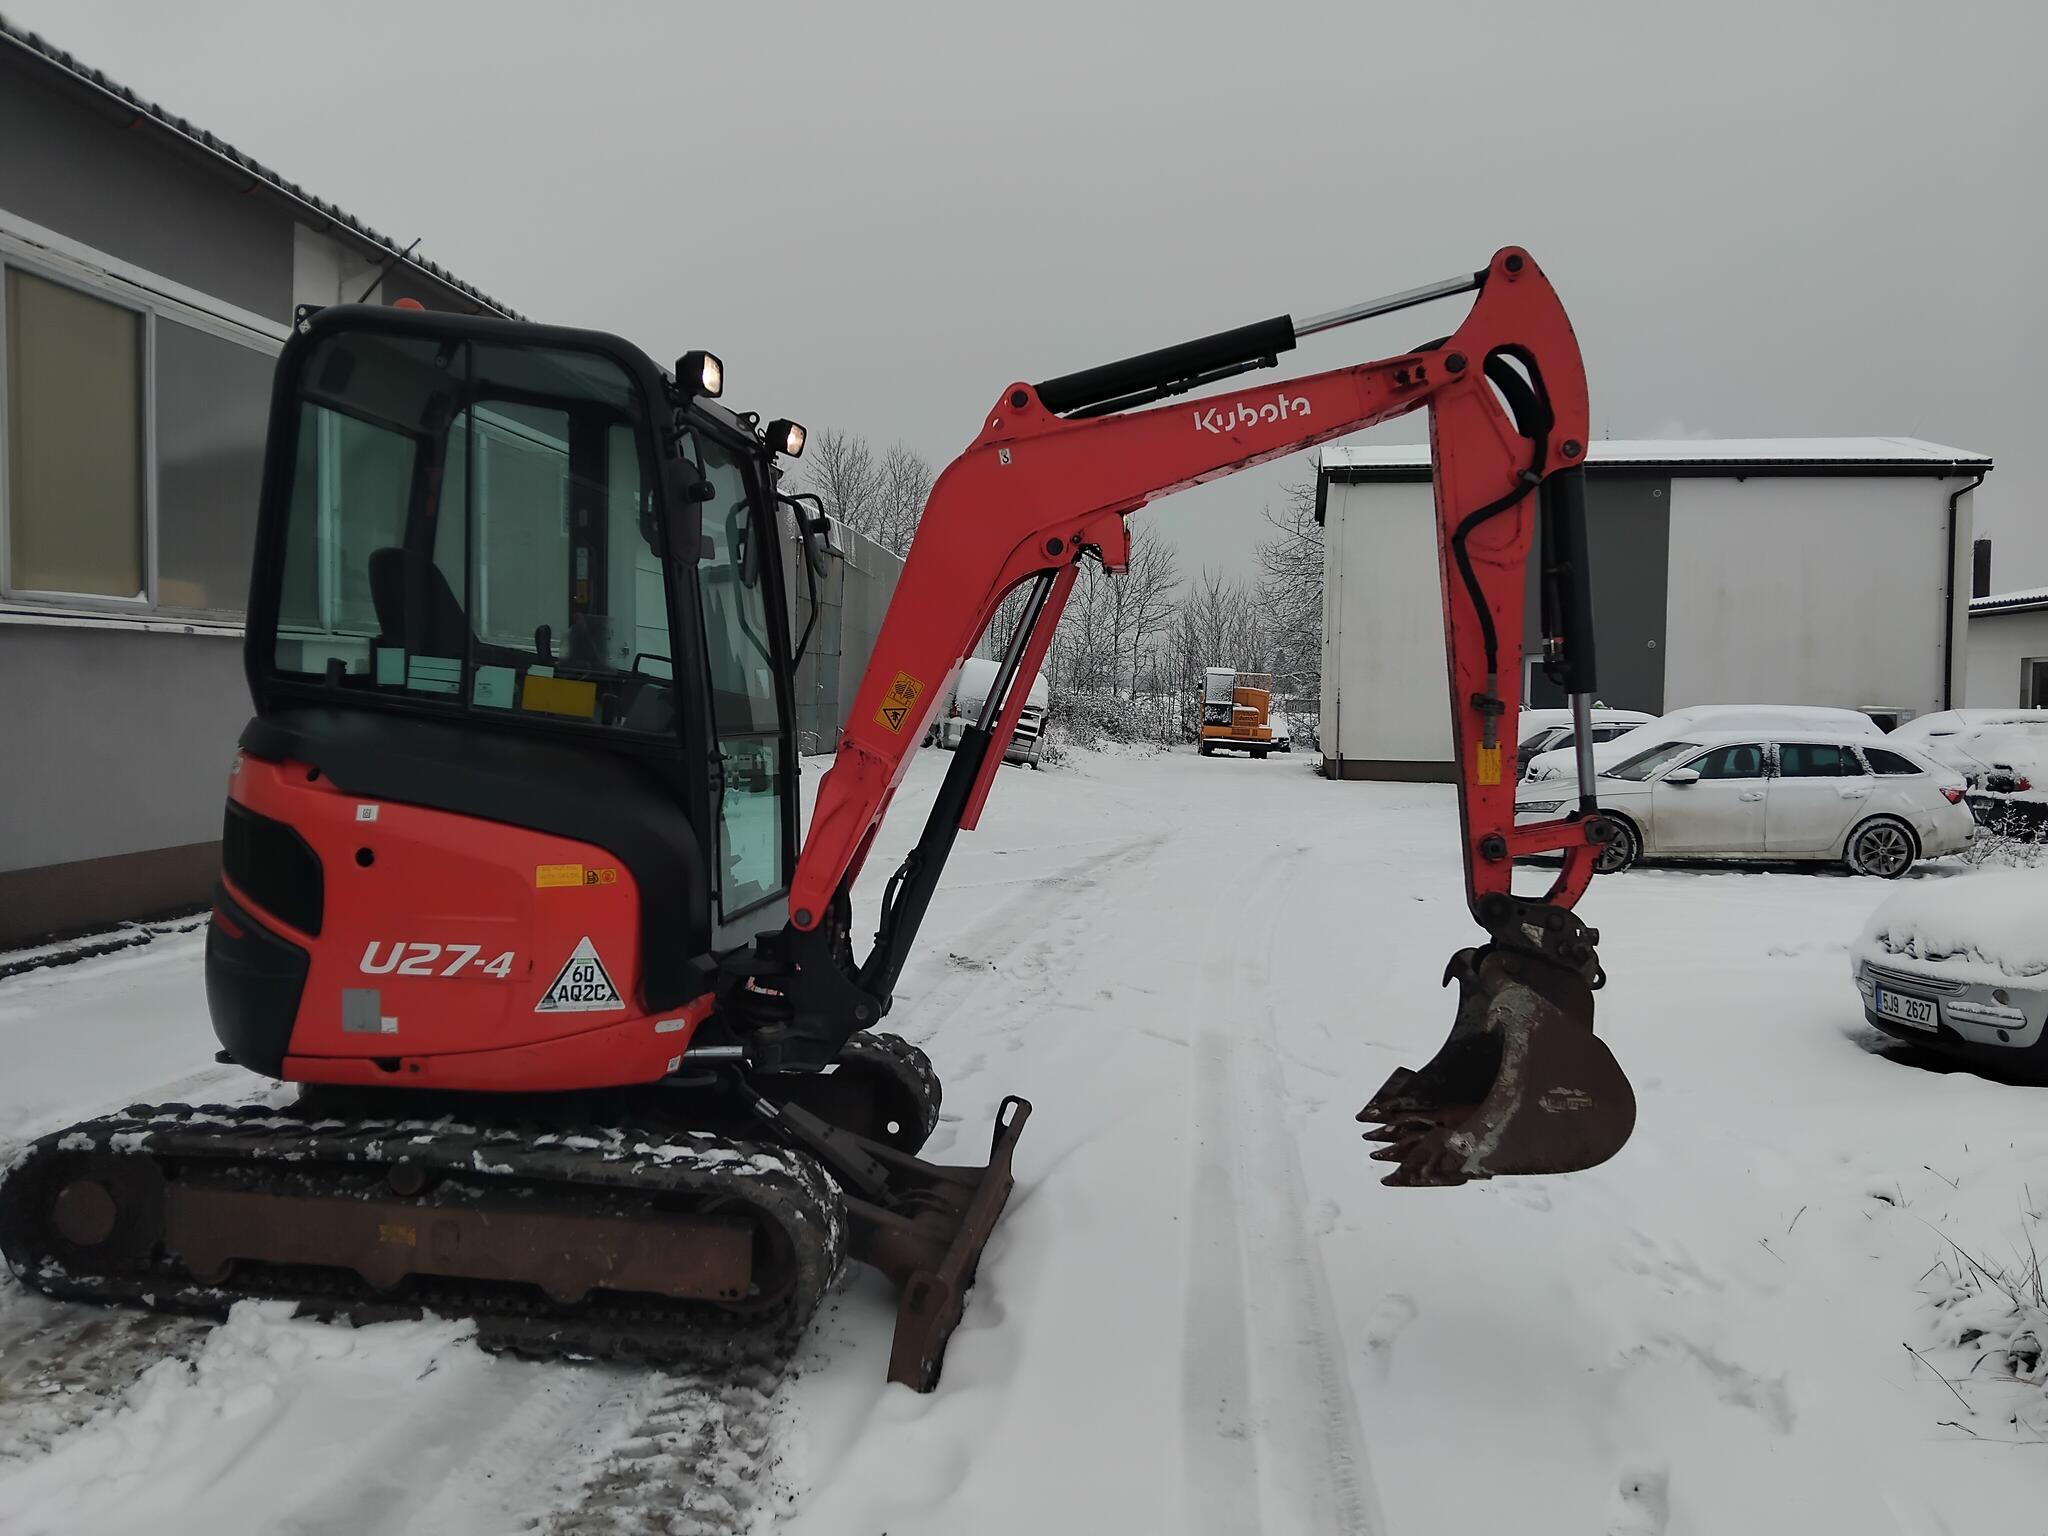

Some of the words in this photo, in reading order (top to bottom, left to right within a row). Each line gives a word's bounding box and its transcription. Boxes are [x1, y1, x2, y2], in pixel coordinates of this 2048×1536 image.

[1193, 393, 1312, 434] Kubota
[359, 941, 515, 978] U27-4
[558, 984, 606, 1002] AQ2C
[1883, 993, 1899, 1013] 5J9
[1906, 999, 1932, 1022] 2627
